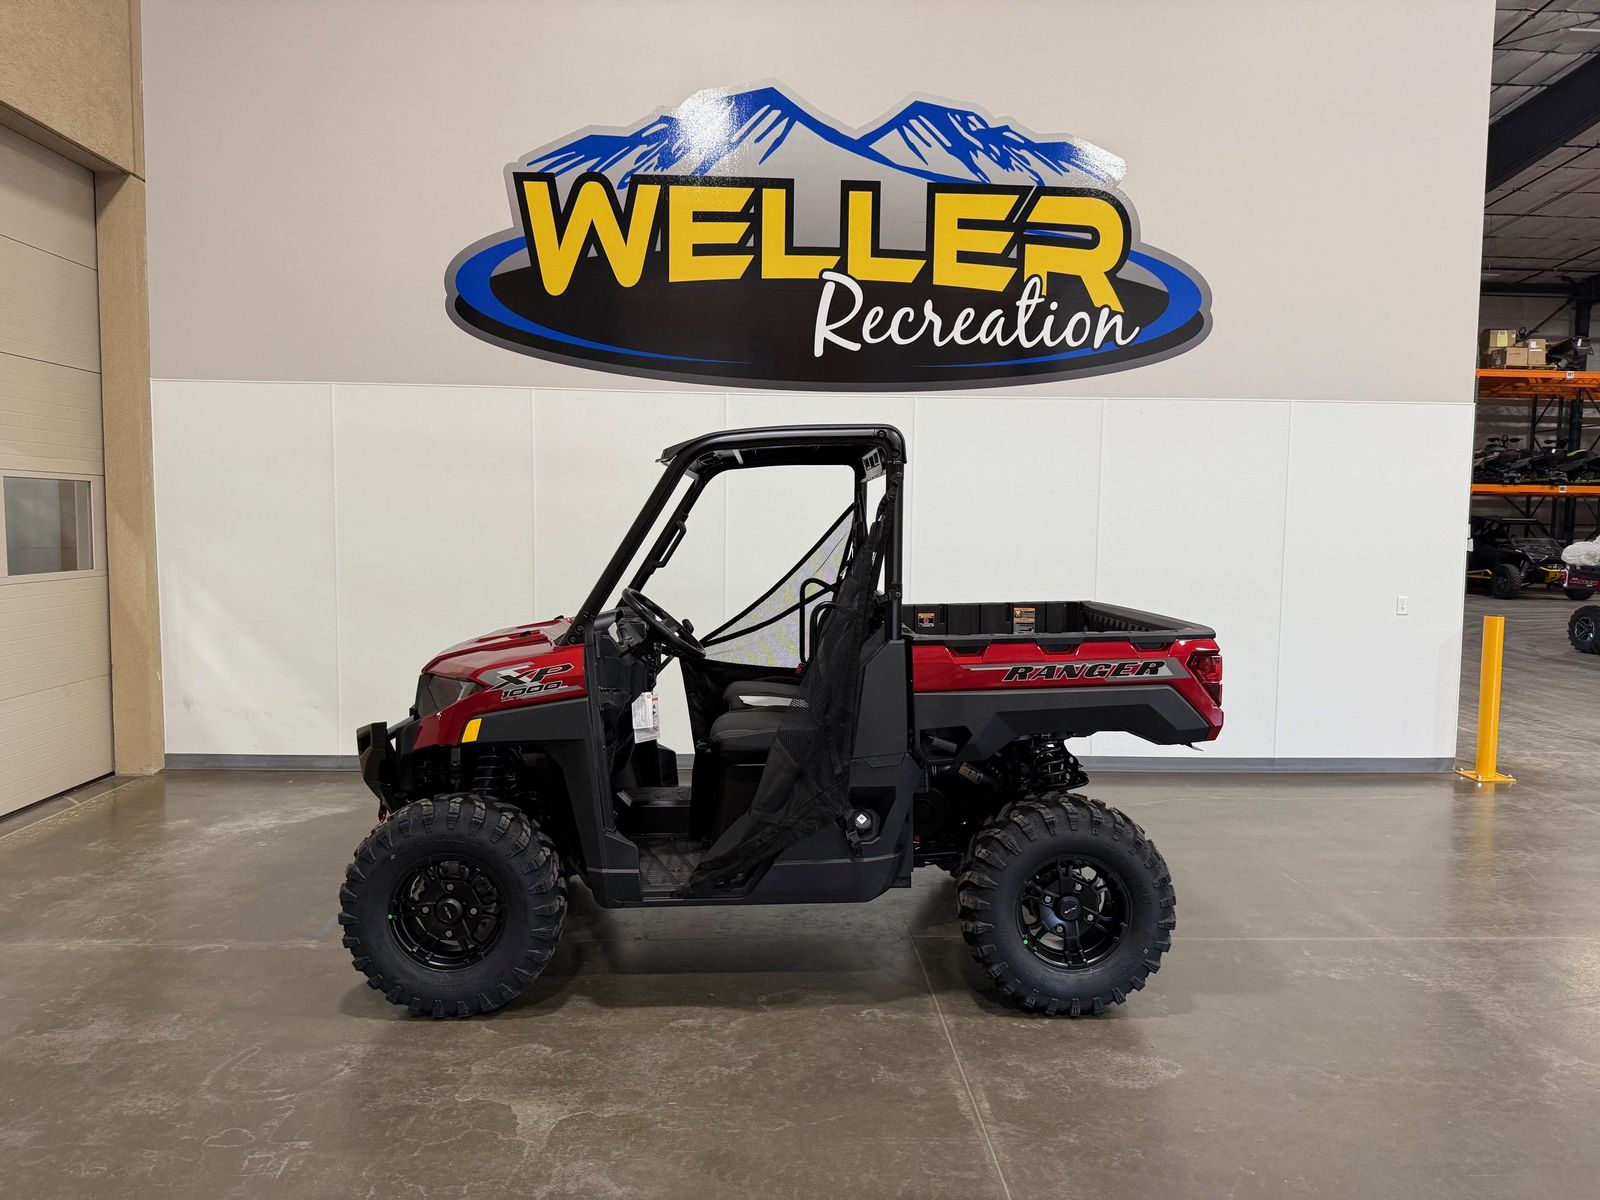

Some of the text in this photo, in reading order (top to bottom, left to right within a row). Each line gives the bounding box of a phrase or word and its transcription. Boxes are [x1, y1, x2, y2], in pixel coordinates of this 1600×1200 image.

[522, 180, 1125, 313] WELLER
[814, 270, 1140, 358] Recreation
[485, 663, 575, 692] XP
[1002, 660, 1166, 682] RANGER
[501, 680, 564, 700] 1000
